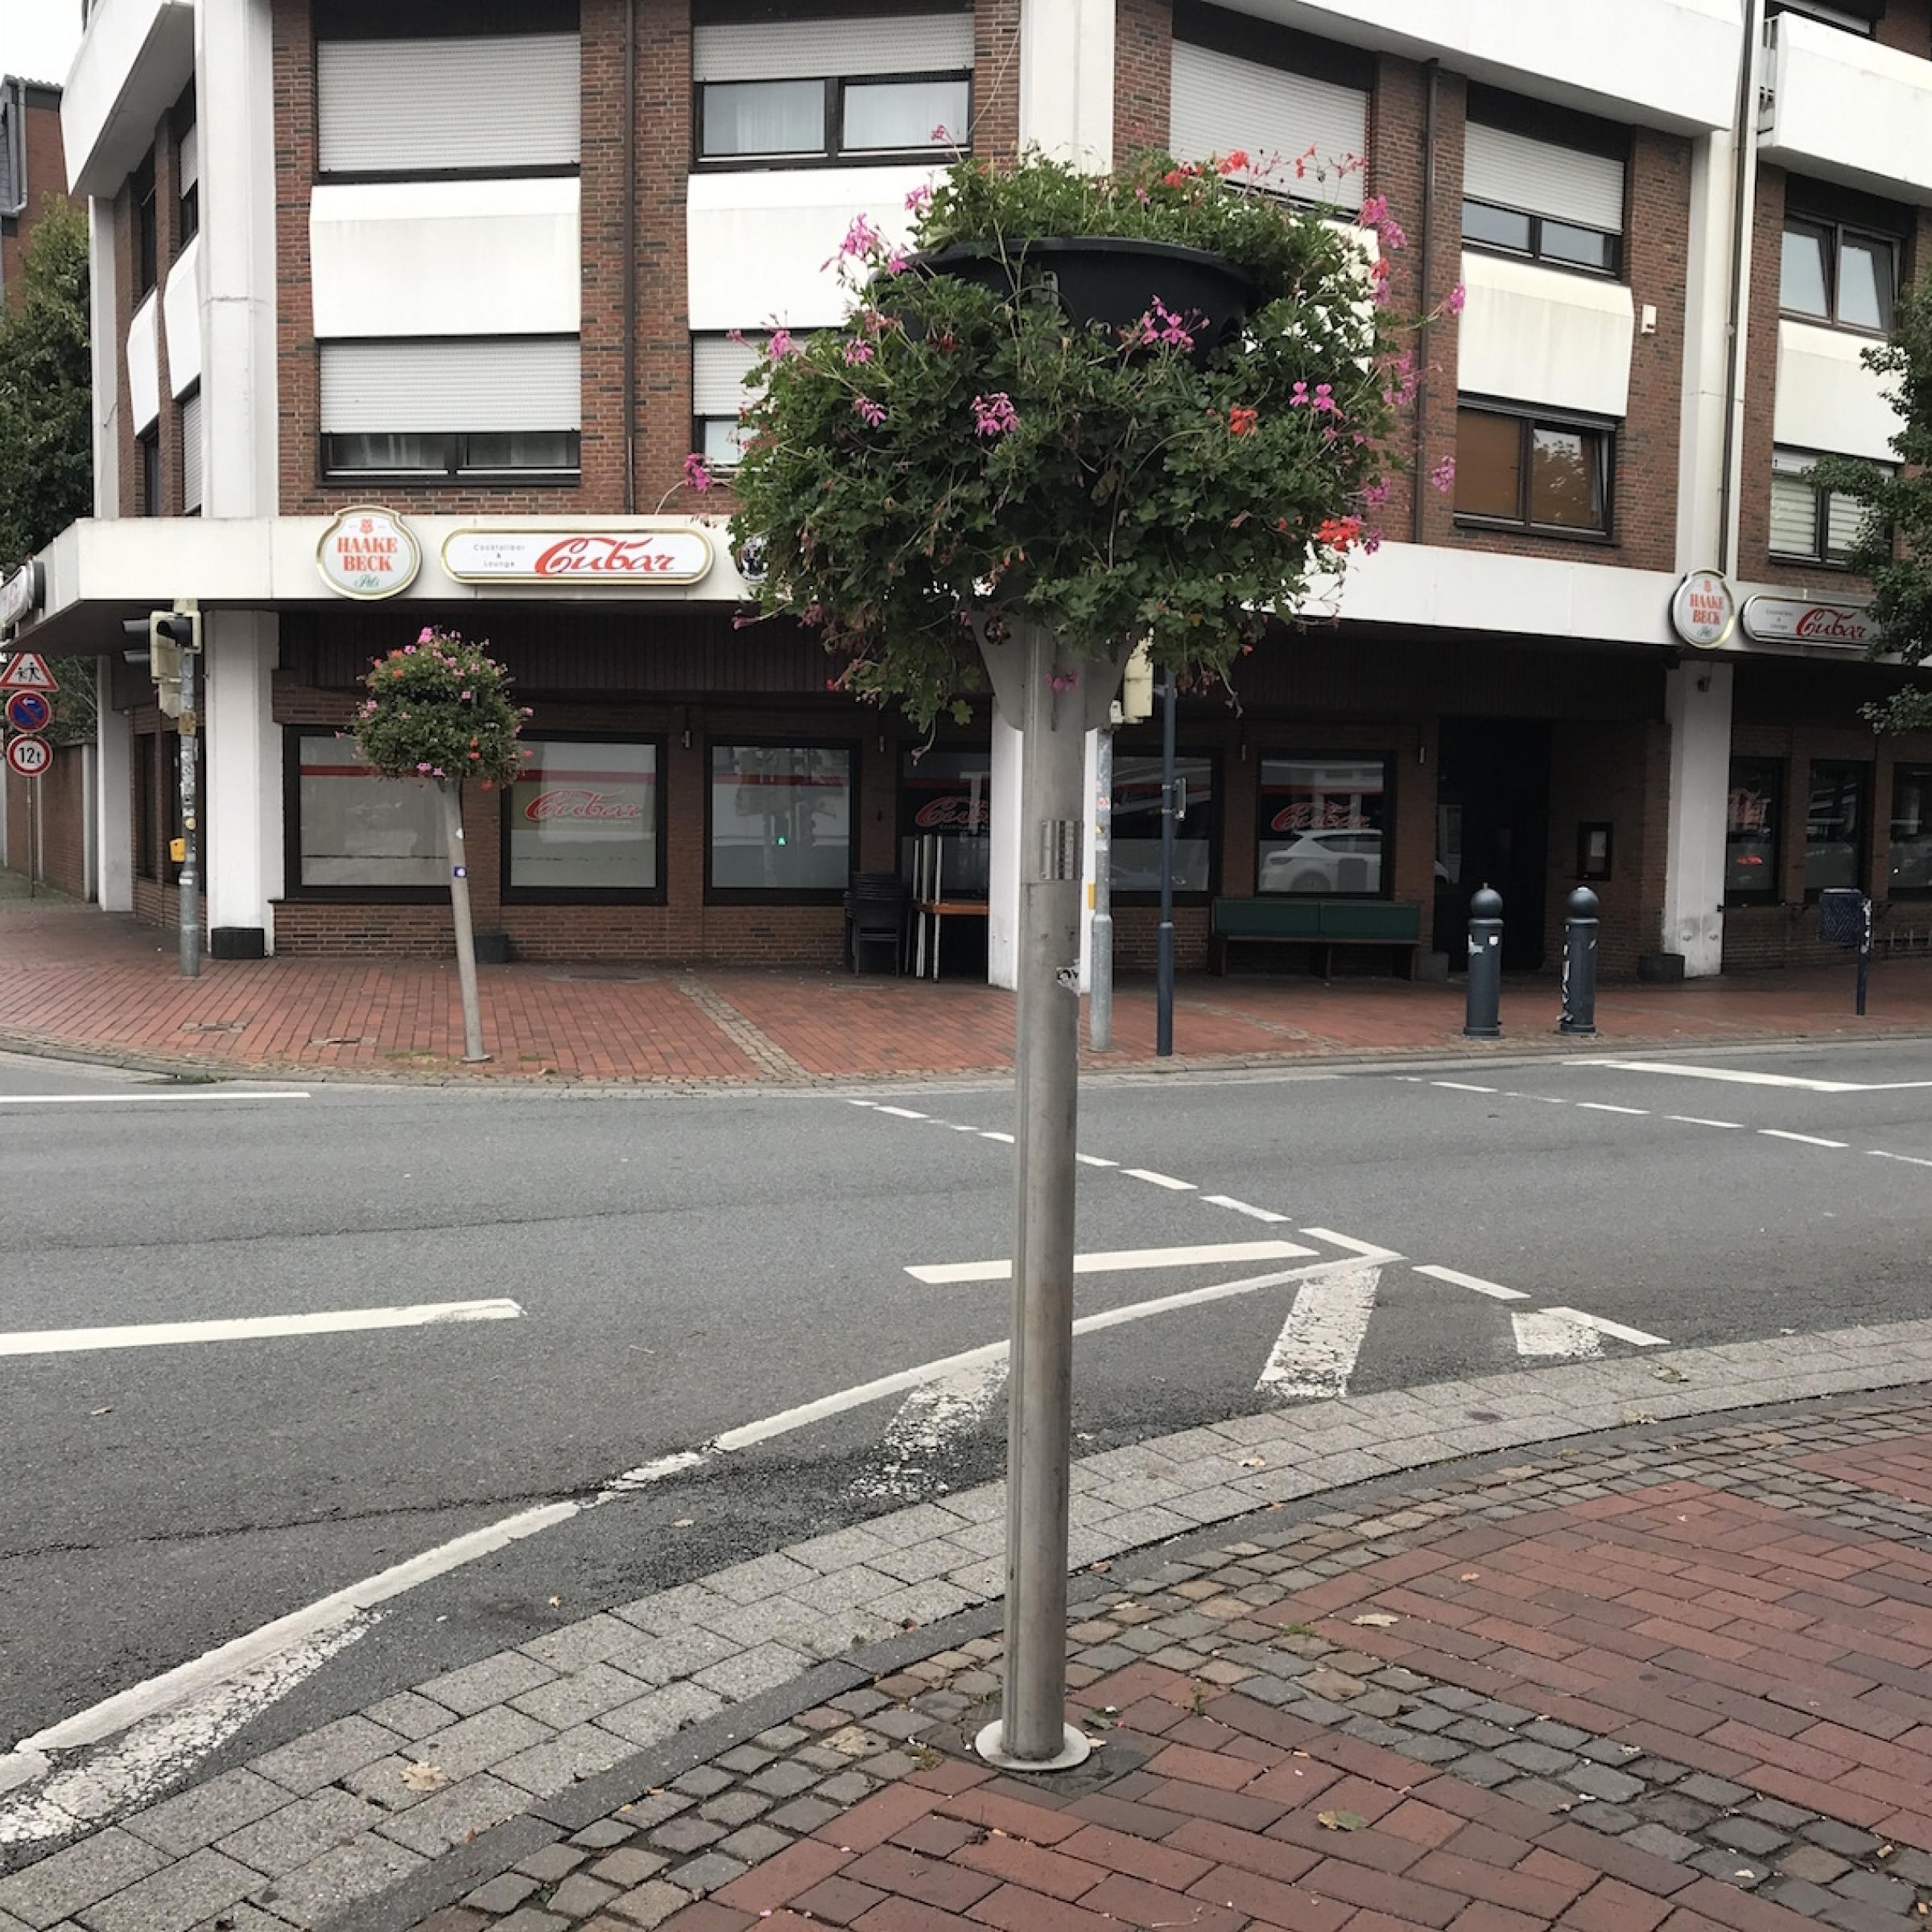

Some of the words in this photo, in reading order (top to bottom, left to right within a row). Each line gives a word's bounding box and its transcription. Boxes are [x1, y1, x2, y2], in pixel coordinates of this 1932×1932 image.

[337, 537, 397, 553] HAAKE
[344, 555, 393, 571] BECK
[1690, 594, 1724, 609] HAAKE
[1693, 609, 1720, 625] BECK
